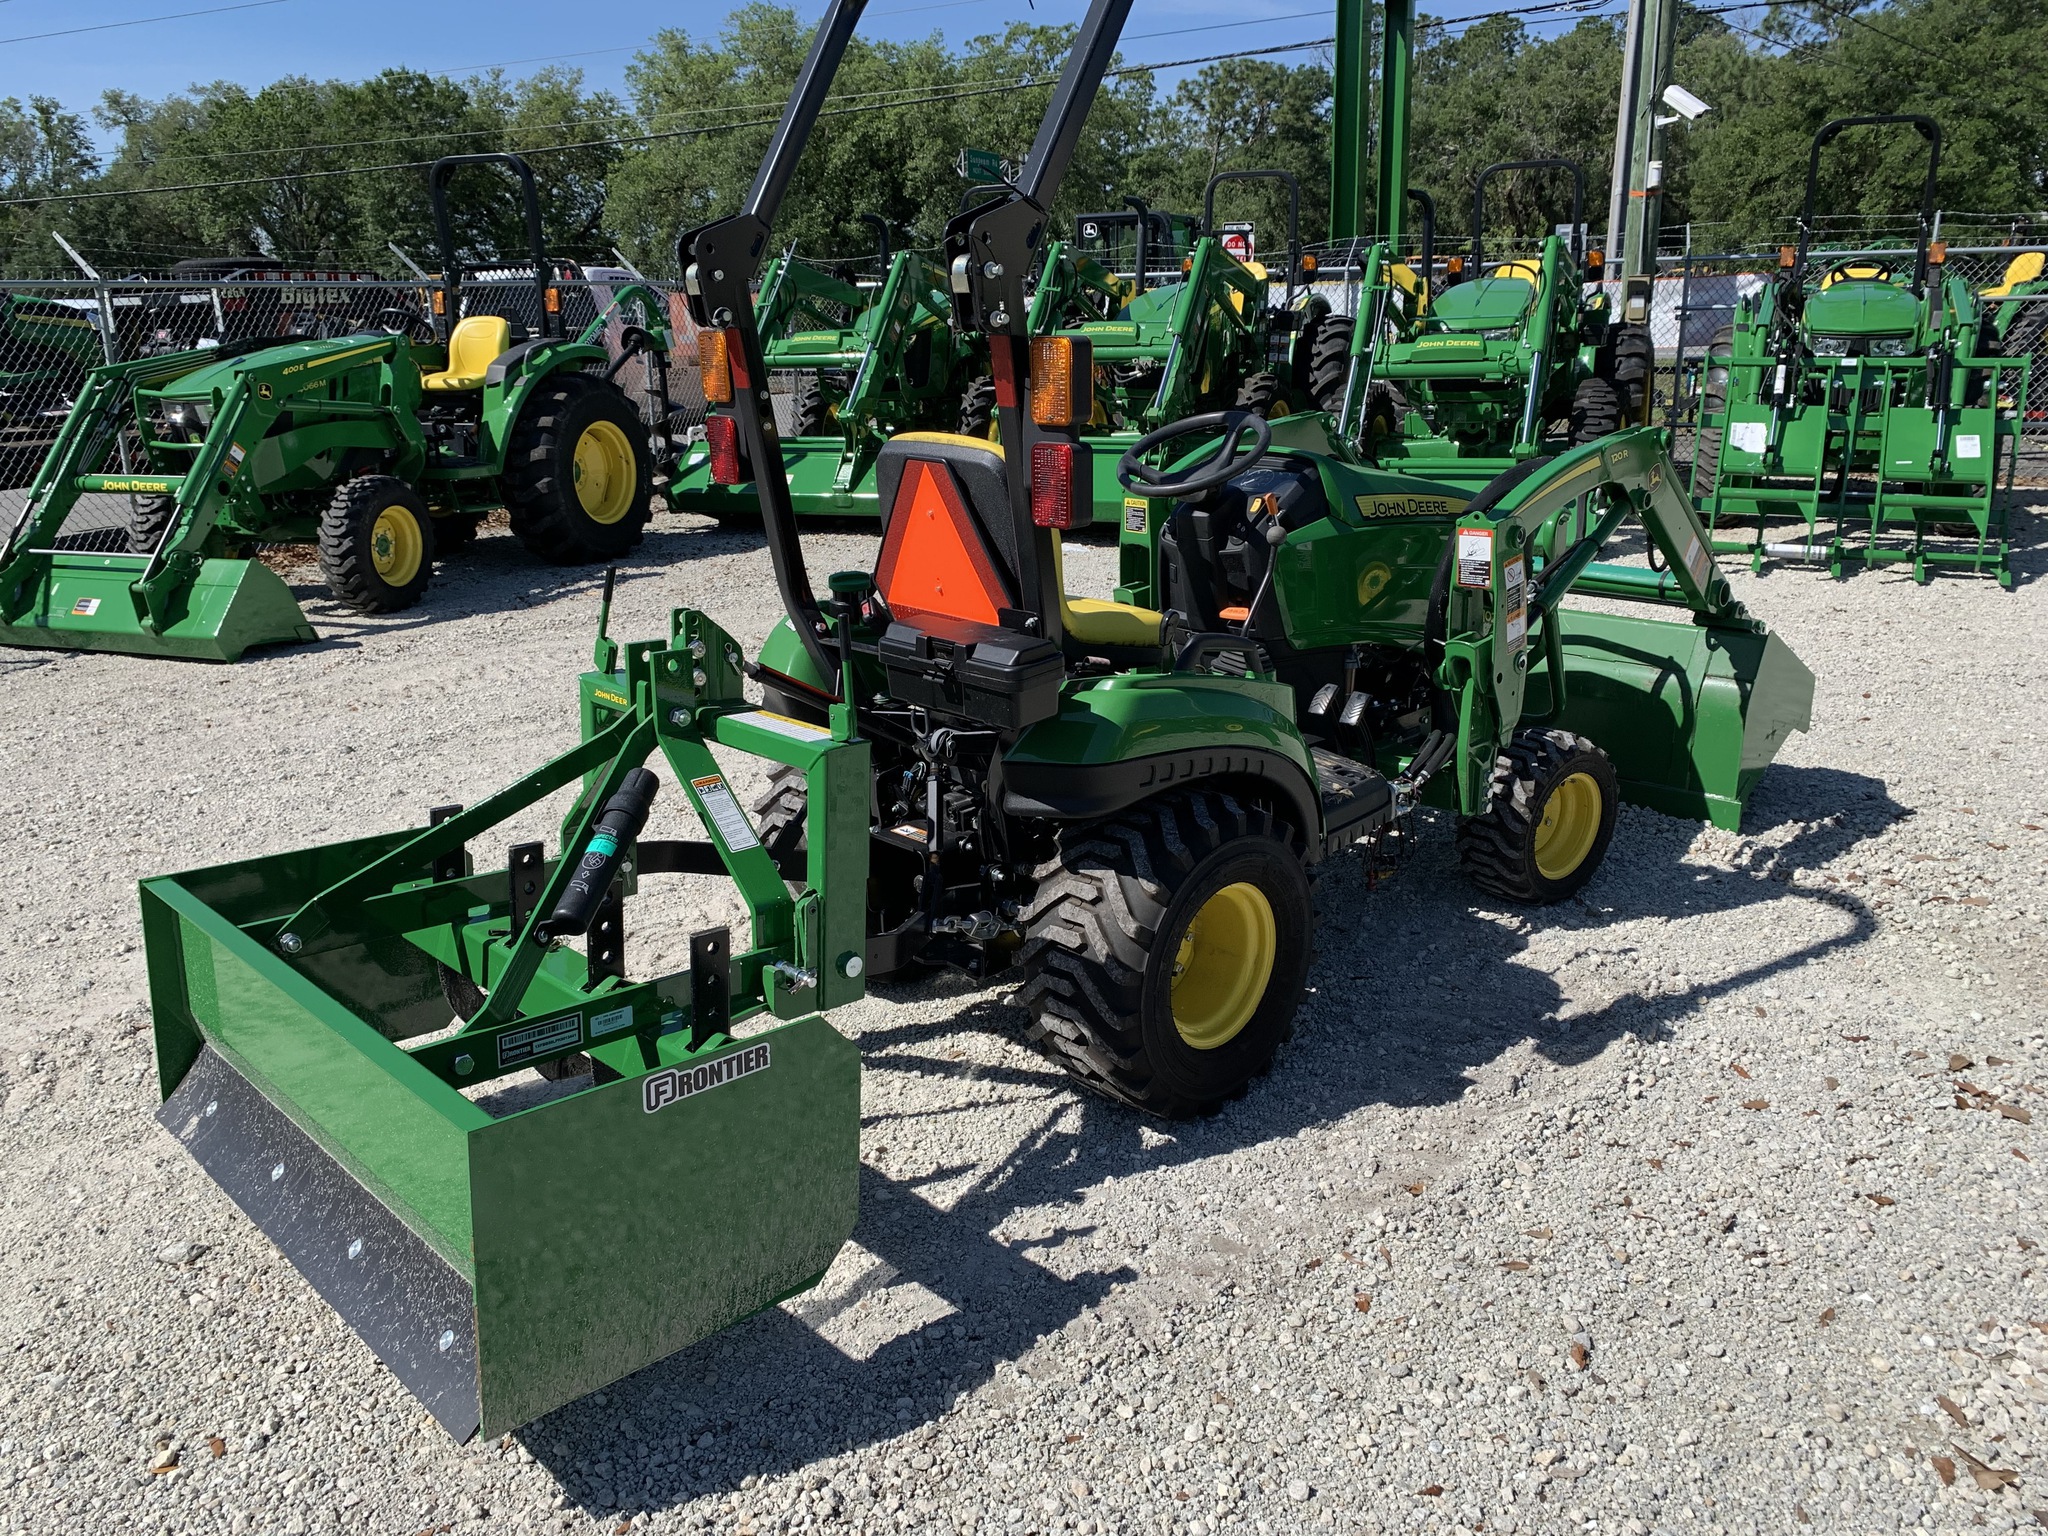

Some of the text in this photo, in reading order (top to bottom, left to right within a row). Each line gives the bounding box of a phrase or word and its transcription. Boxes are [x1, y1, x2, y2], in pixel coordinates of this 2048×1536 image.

[101, 480, 168, 492] JOHN DEERE
[1370, 498, 1449, 517] JOHN DEERE
[594, 688, 628, 706] JOHN DEER
[645, 1044, 769, 1112] FRONTIER
